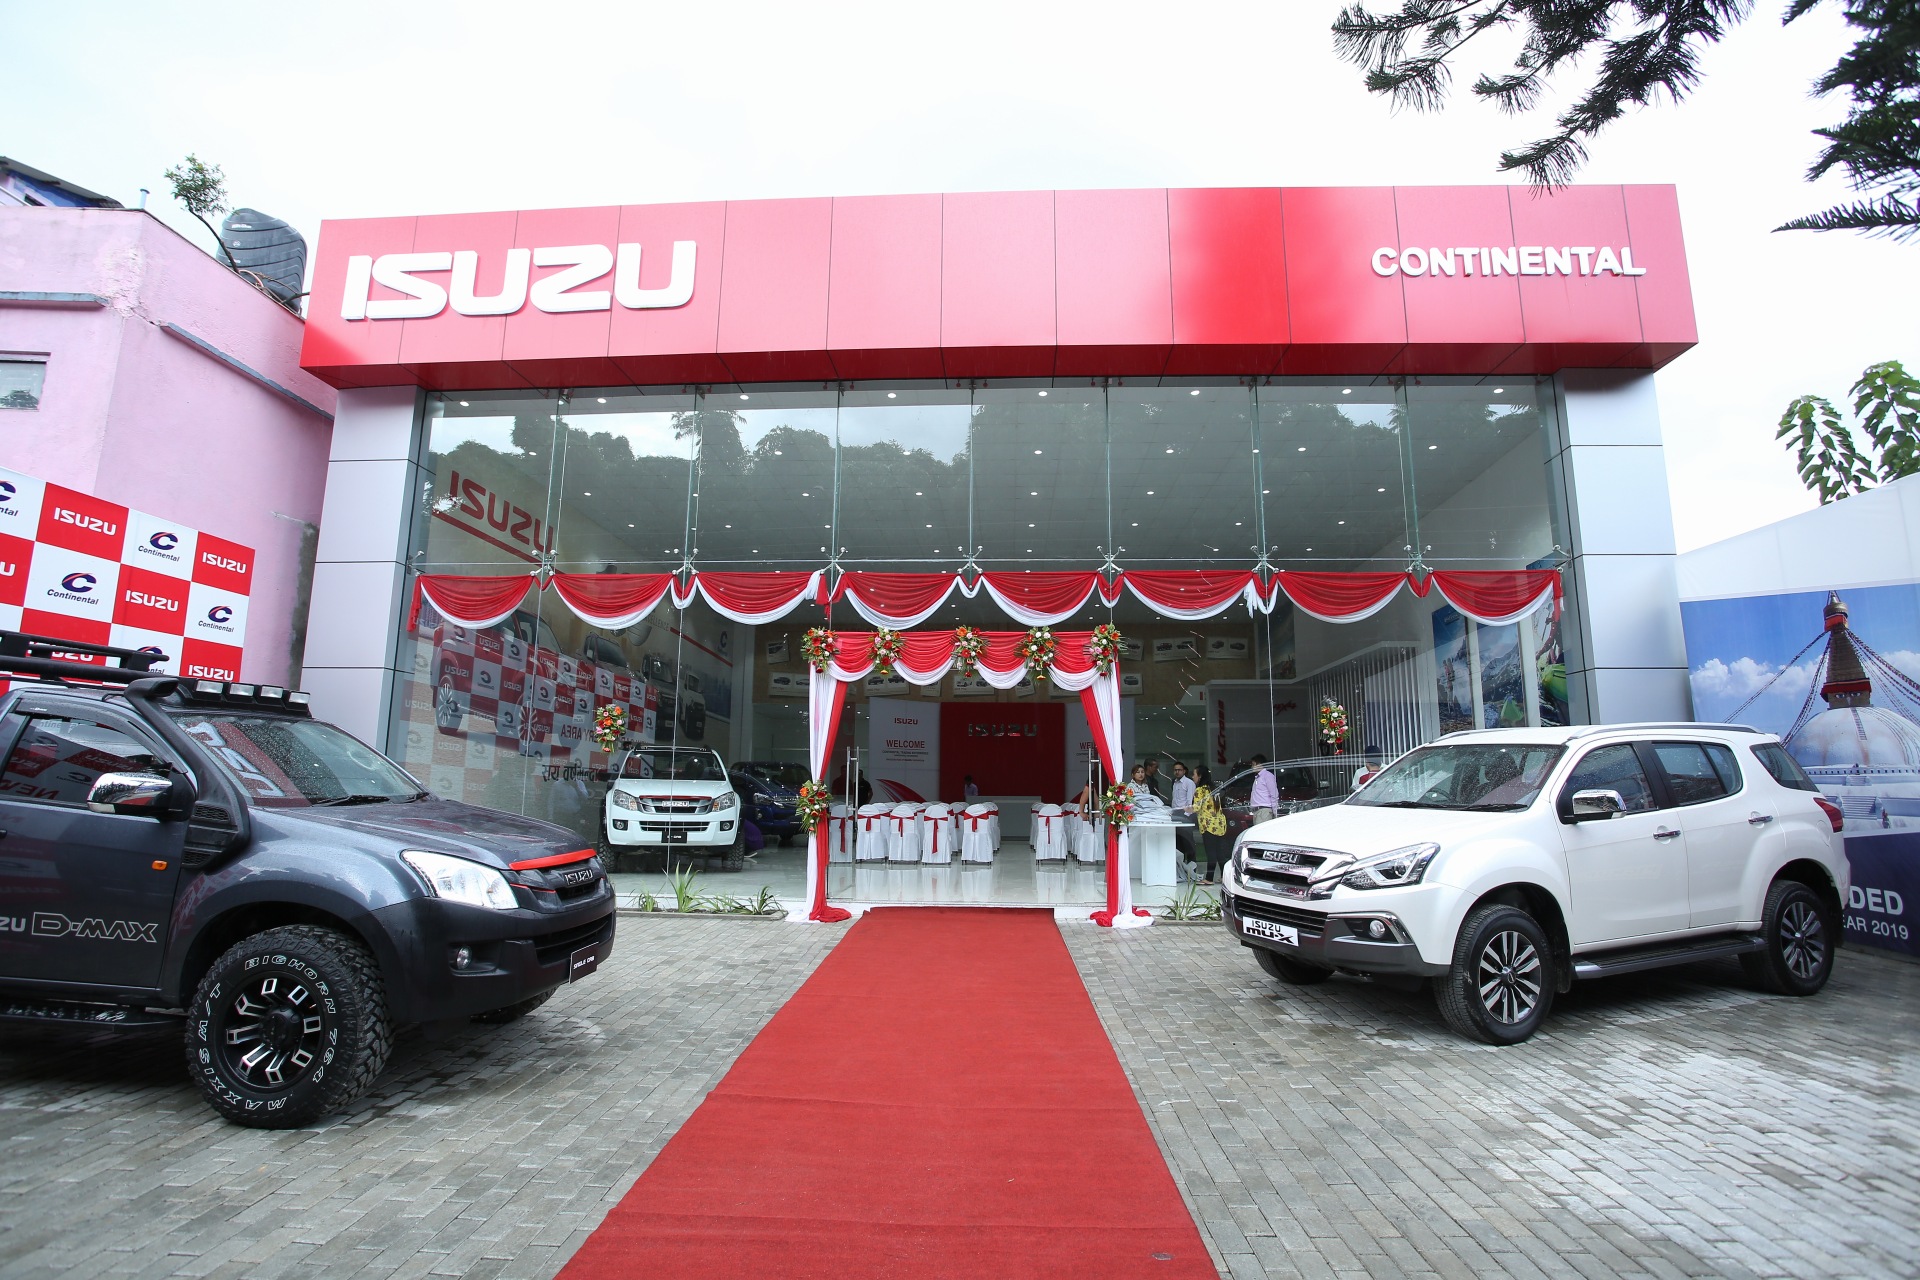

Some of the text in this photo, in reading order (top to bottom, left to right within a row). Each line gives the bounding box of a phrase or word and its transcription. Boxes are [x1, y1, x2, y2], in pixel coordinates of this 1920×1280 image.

[1371, 246, 1647, 278] CONTINENTAL
[340, 240, 697, 320] ISUZU
[450, 470, 554, 554] ISUZU
[54, 507, 117, 536] ISUZU
[138, 545, 180, 562] Continental
[202, 551, 247, 574] ISUZU
[47, 589, 99, 605] Continental
[125, 590, 179, 612] ISUZU
[198, 620, 235, 633] Continental
[188, 664, 235, 681] ISUZU
[893, 717, 918, 725] ISUZU
[968, 723, 1038, 737] ISUZU
[886, 739, 925, 749] WELCOME
[1262, 850, 1299, 864] ISUZU
[565, 869, 593, 886] ISUZU
[1251, 920, 1281, 933] ISUZU
[1872, 920, 1909, 940] 2019
[245, 955, 336, 1014] BIGHORN
[199, 1048, 287, 1110] MAXXIS
